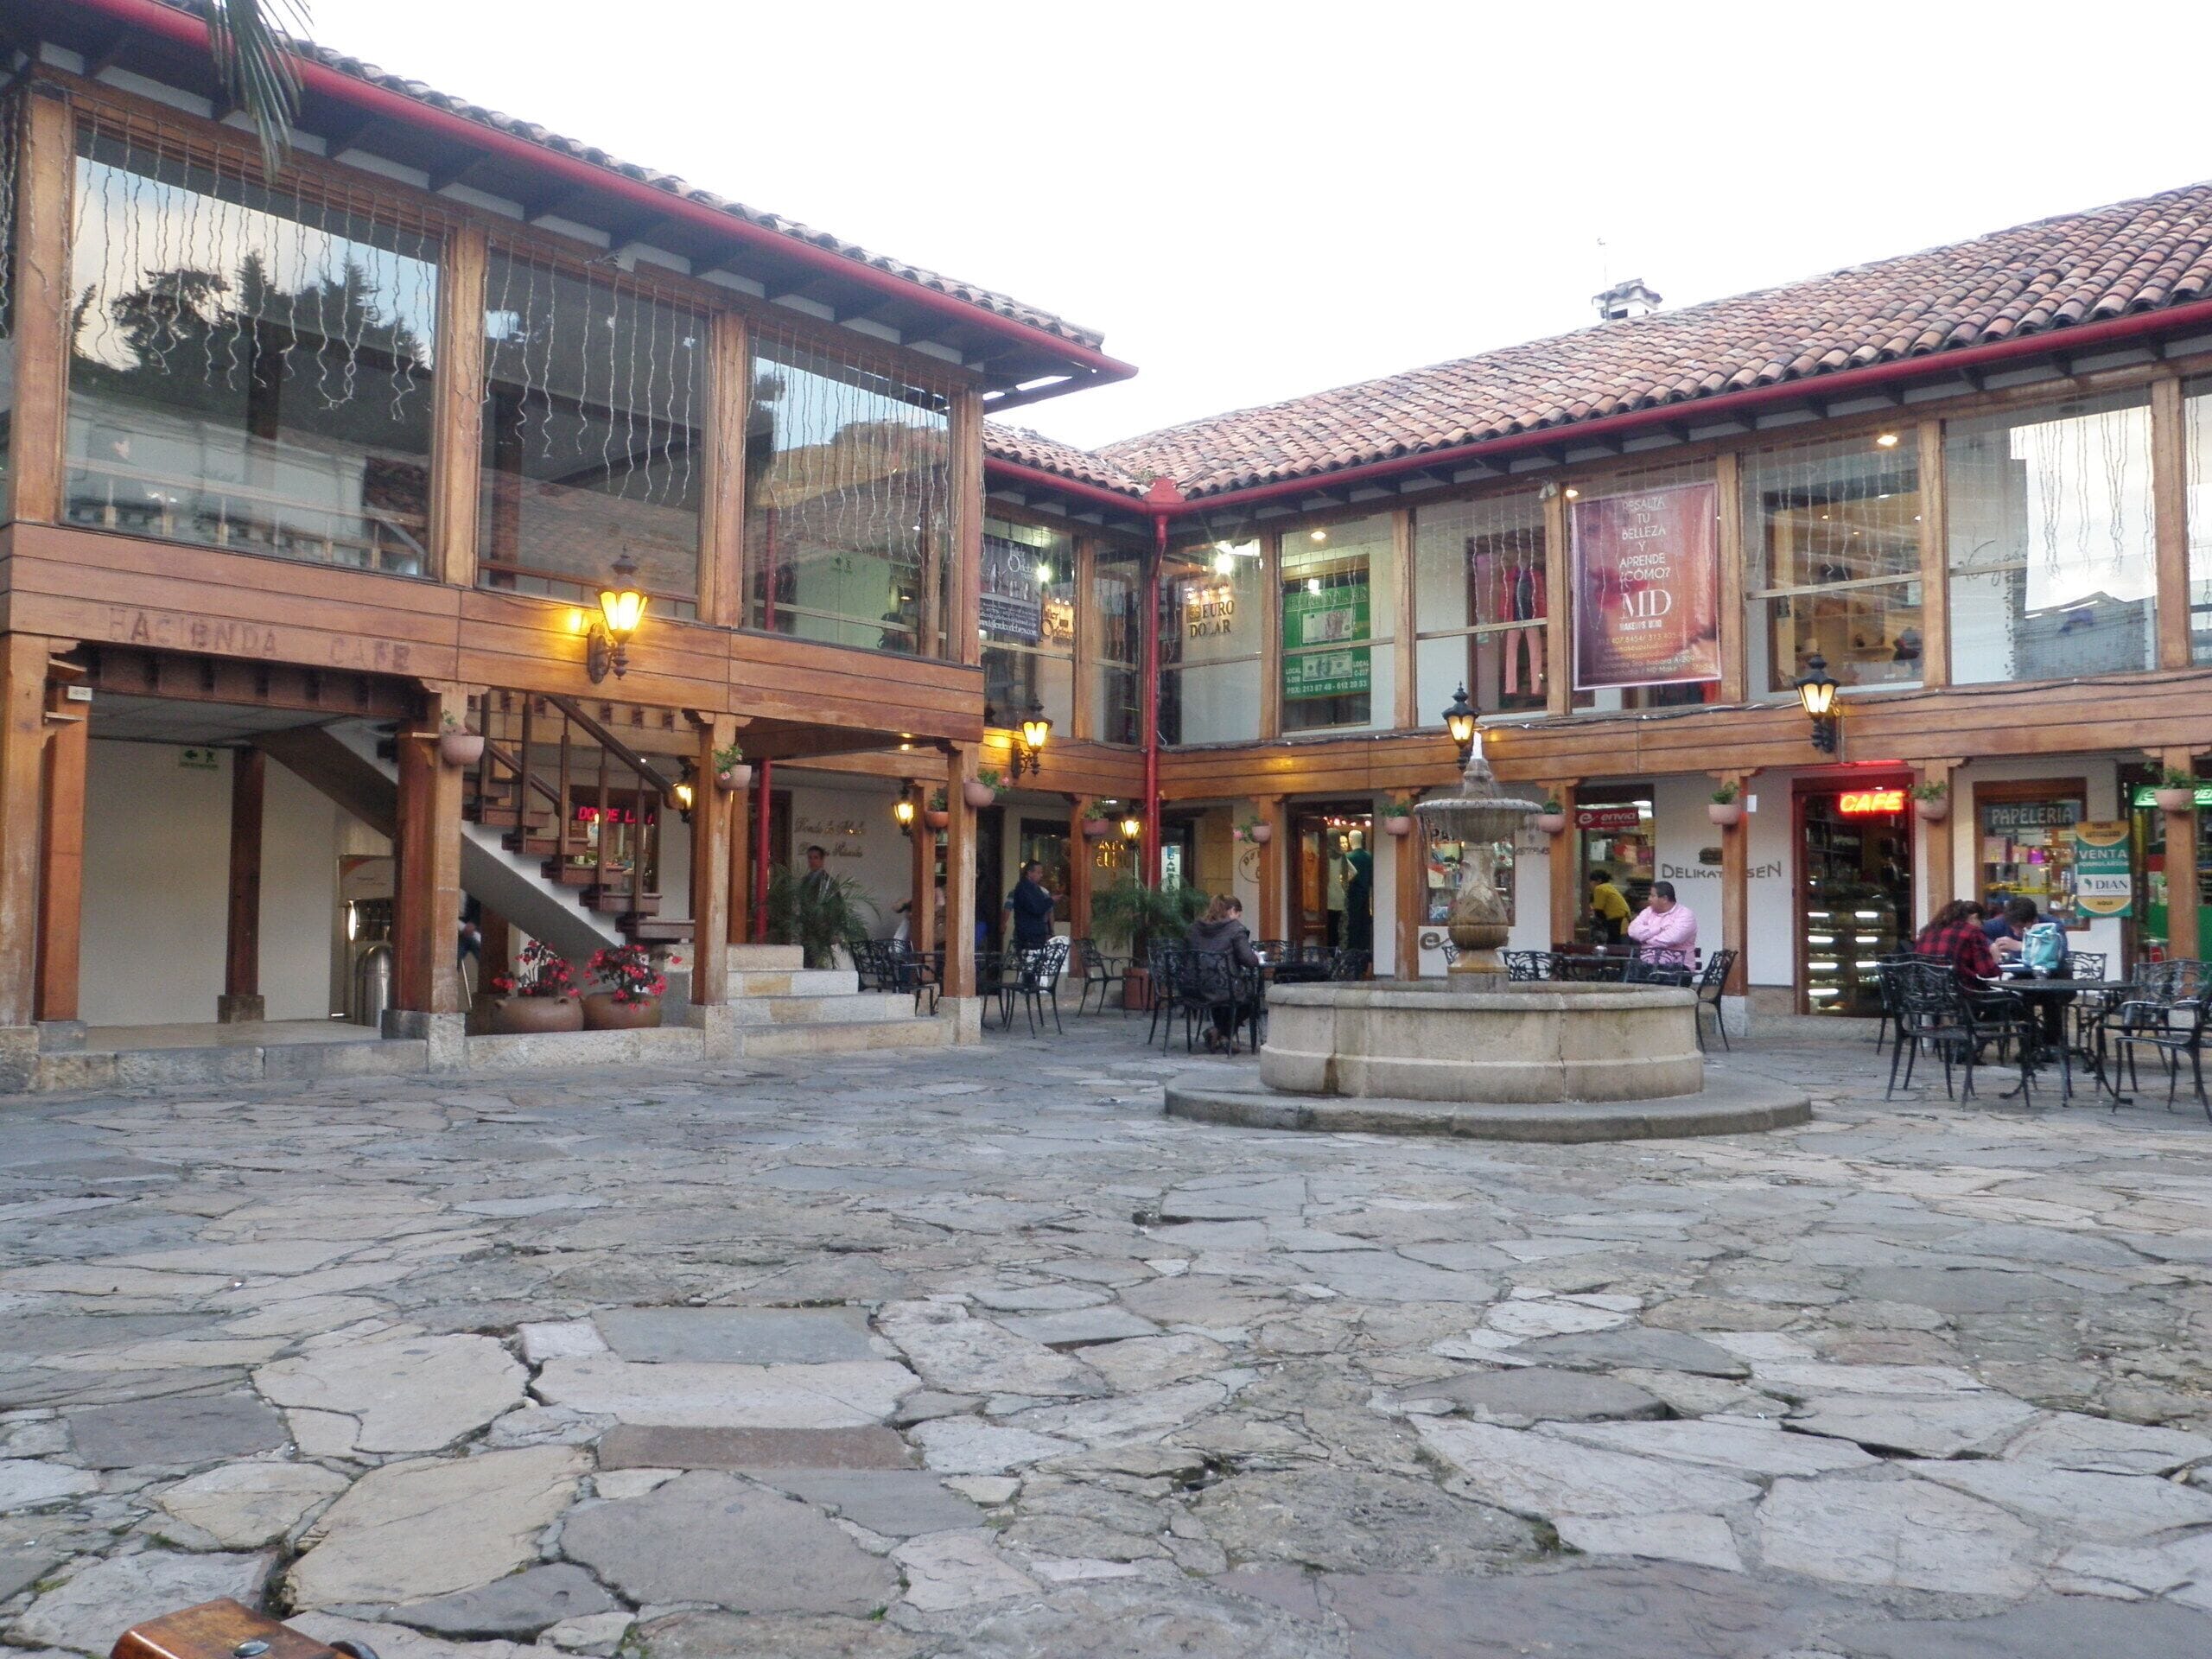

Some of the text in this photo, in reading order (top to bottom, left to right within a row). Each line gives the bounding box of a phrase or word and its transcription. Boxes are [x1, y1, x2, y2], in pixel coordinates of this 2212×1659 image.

[1637, 512, 1650, 524] TU
[1622, 524, 1666, 540] BELLEZA
[1638, 541, 1646, 551] Y
[1619, 553, 1666, 568] APRENDE
[1202, 600, 1235, 619] EURO
[1620, 588, 1672, 619] MD
[109, 607, 276, 658] HACIENDA
[330, 635, 412, 673] CAFE
[1991, 807, 2074, 825] PAPELERIA
[2079, 849, 2128, 859] VENTA
[1662, 861, 1782, 880] DELIKATSEN
[2095, 880, 2128, 889] DIAN
